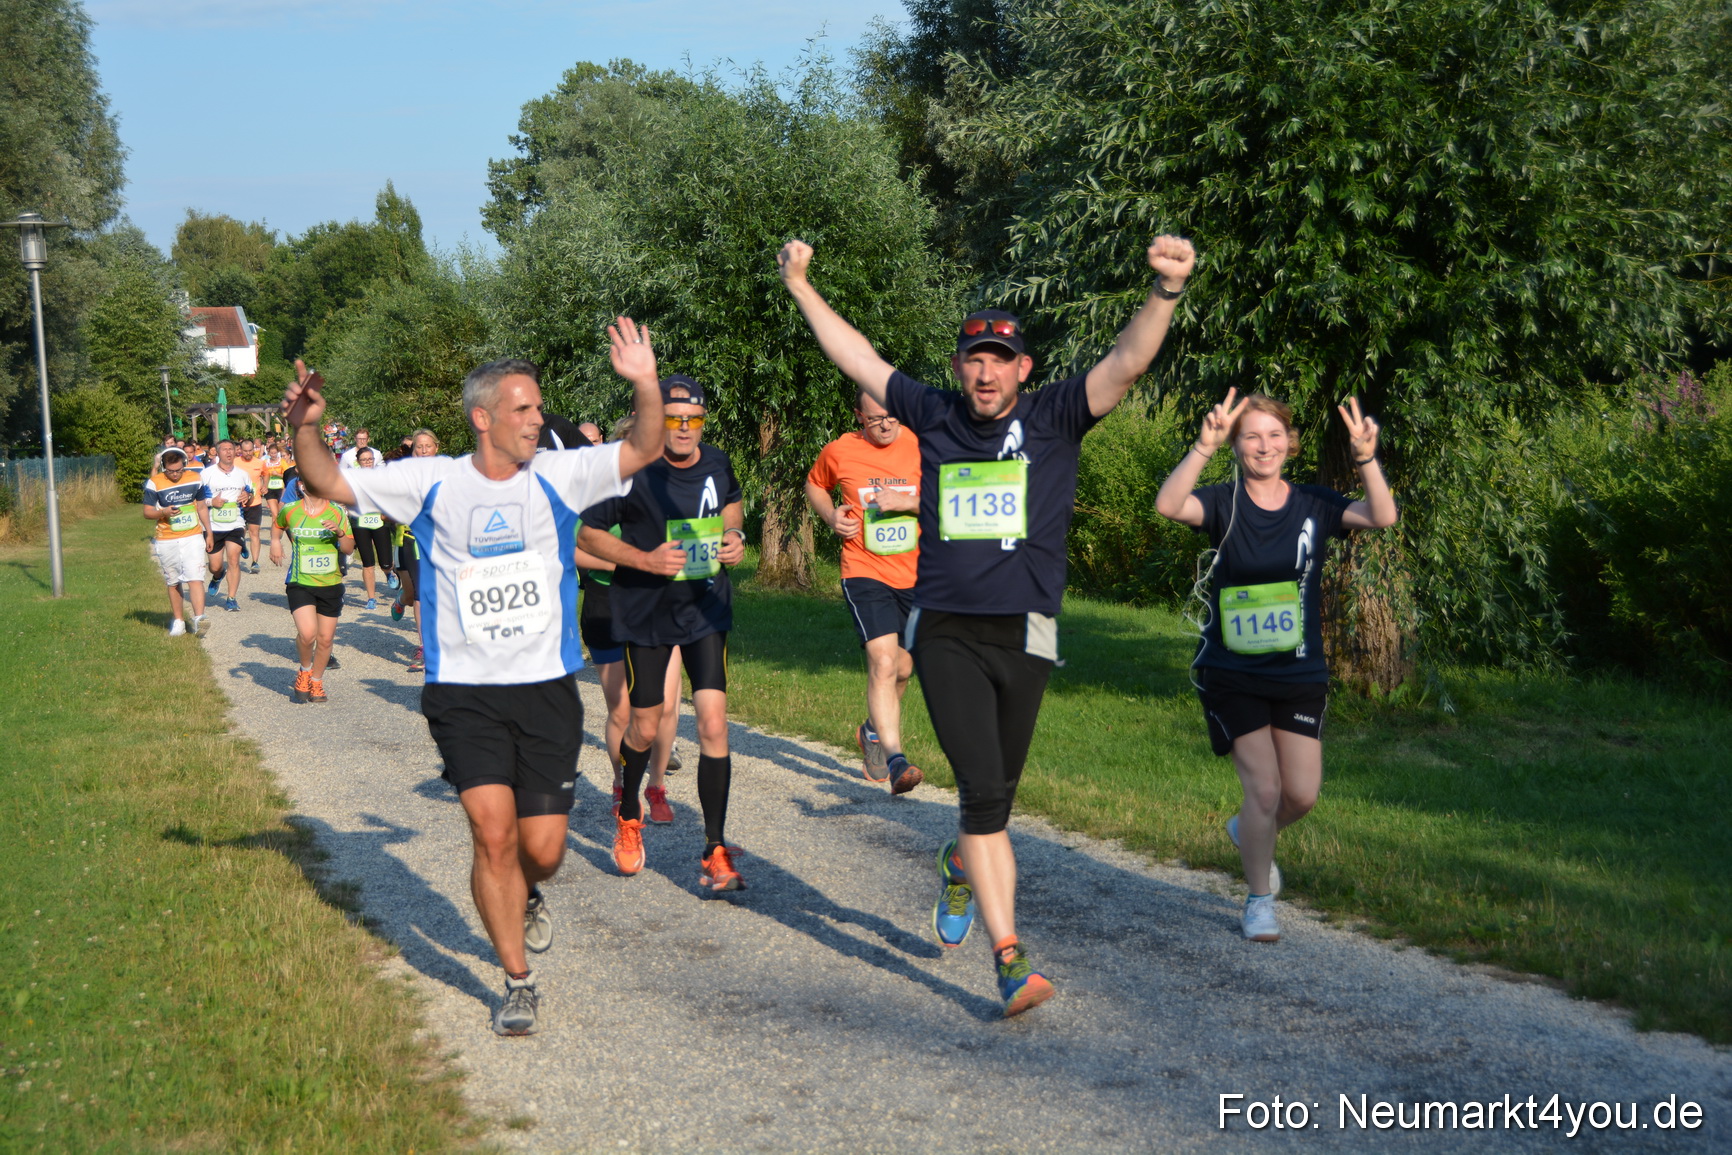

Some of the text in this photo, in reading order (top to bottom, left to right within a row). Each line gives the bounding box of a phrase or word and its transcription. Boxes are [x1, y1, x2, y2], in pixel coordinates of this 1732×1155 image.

[884, 477, 907, 485] Jahre
[949, 492, 1016, 518] 1138
[876, 526, 907, 542] 620
[308, 556, 330, 568] 153
[469, 580, 540, 616] 8928
[1230, 610, 1294, 636] 1146
[1294, 712, 1315, 724] JAKO
